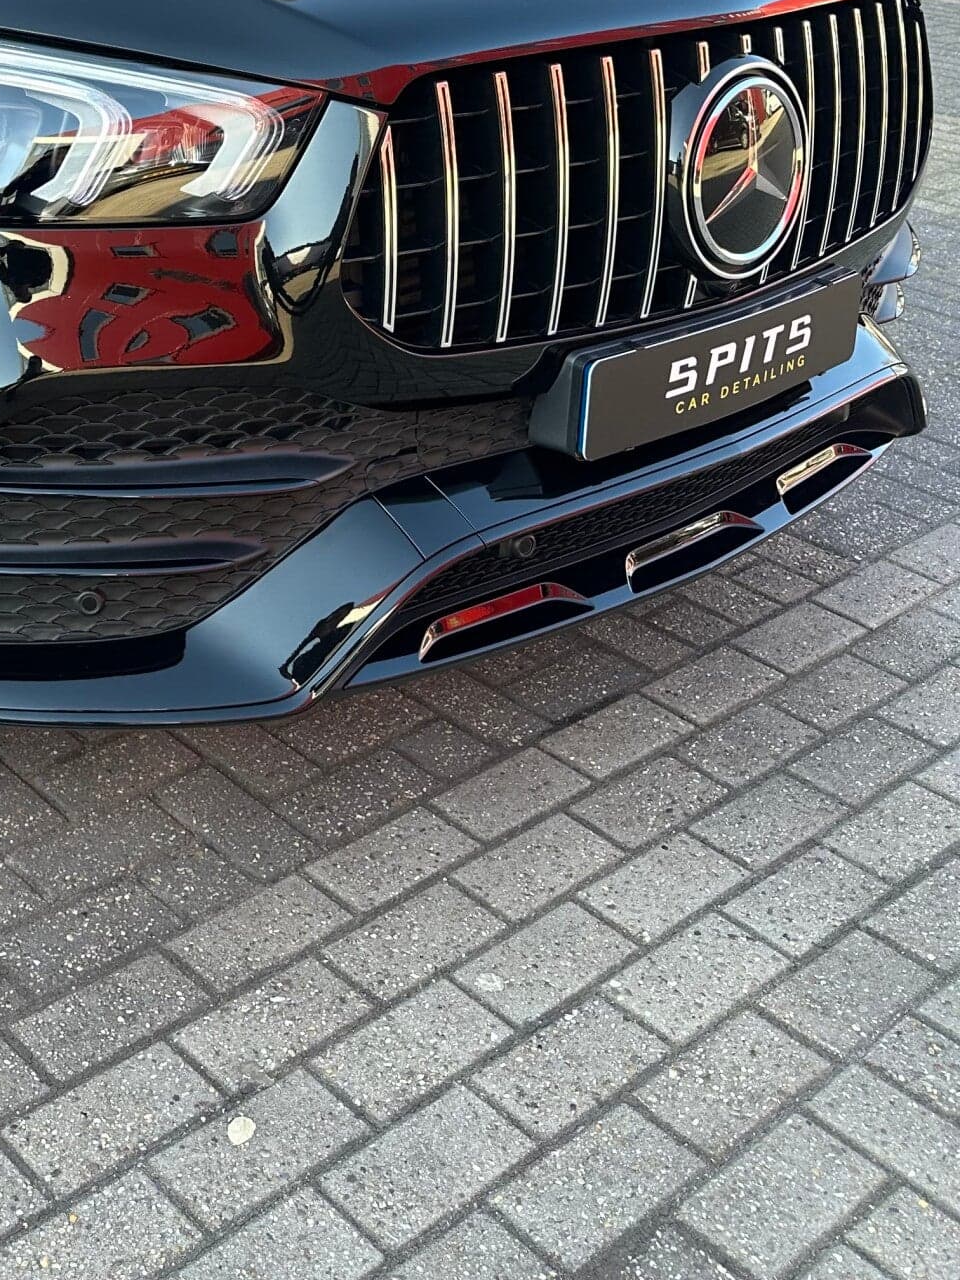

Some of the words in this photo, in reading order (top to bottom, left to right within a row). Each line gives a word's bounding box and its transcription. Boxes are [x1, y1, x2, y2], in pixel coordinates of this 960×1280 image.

[665, 314, 812, 399] SPITS
[675, 392, 710, 414] CAR
[720, 354, 806, 399] DETAILING
